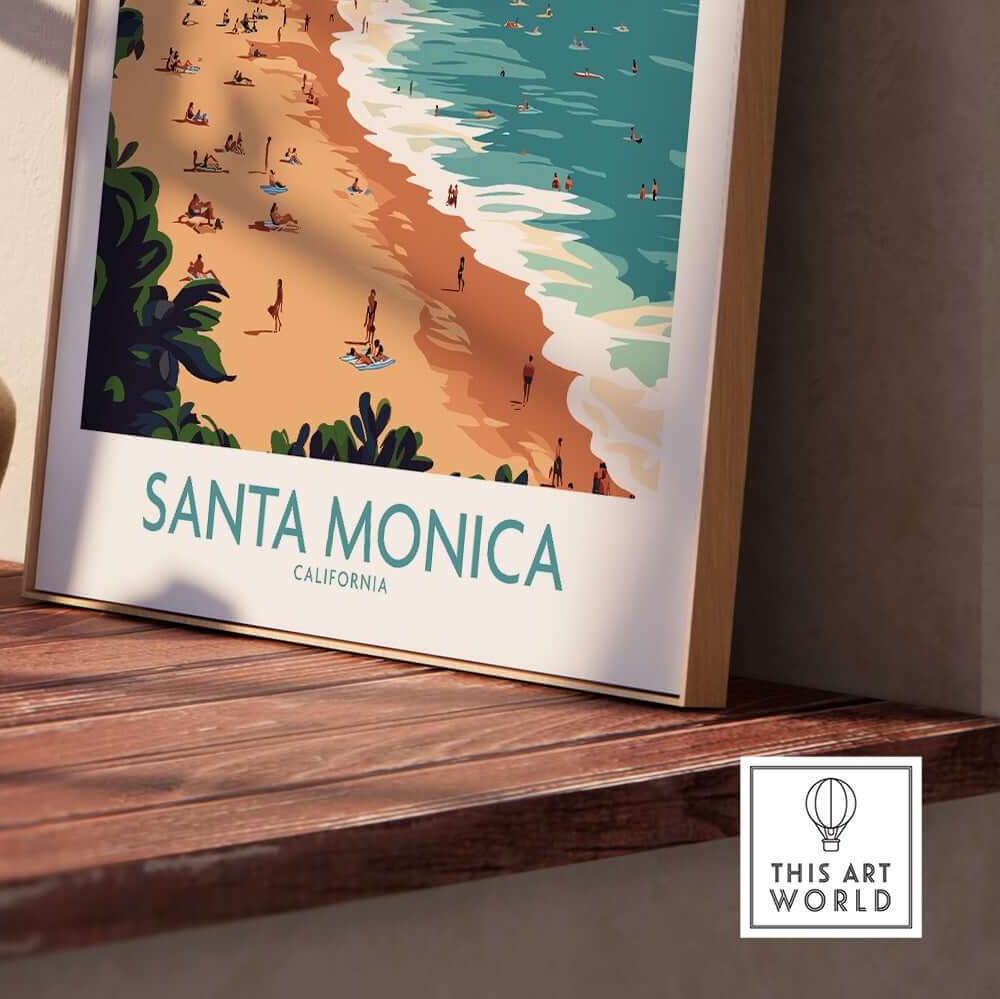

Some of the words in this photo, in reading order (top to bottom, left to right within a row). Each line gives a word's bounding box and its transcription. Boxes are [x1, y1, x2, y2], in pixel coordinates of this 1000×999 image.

[142, 471, 306, 553] SANTA
[325, 495, 563, 591] MONICA
[293, 564, 388, 593] CALIFORNIA
